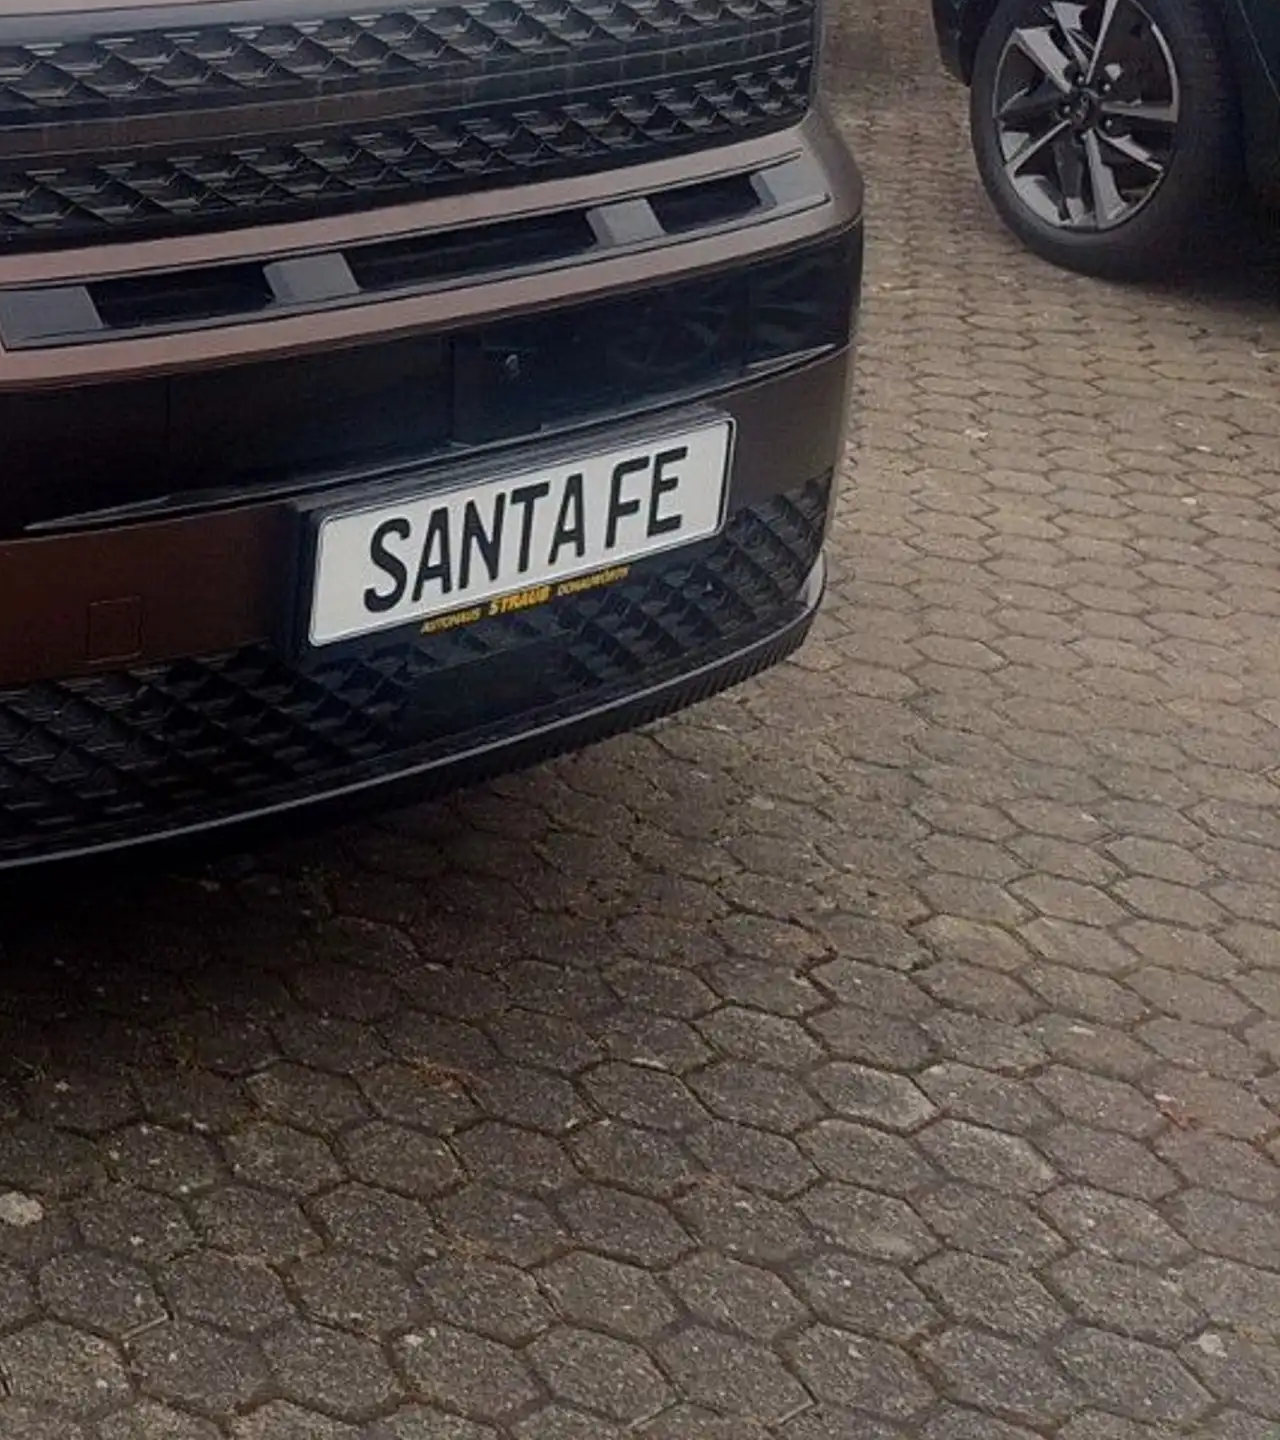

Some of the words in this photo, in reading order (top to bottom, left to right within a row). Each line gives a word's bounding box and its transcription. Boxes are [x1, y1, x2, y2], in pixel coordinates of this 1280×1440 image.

[364, 472, 585, 613] SANTA
[605, 446, 688, 548] FE
[488, 585, 552, 616] STRAUB
